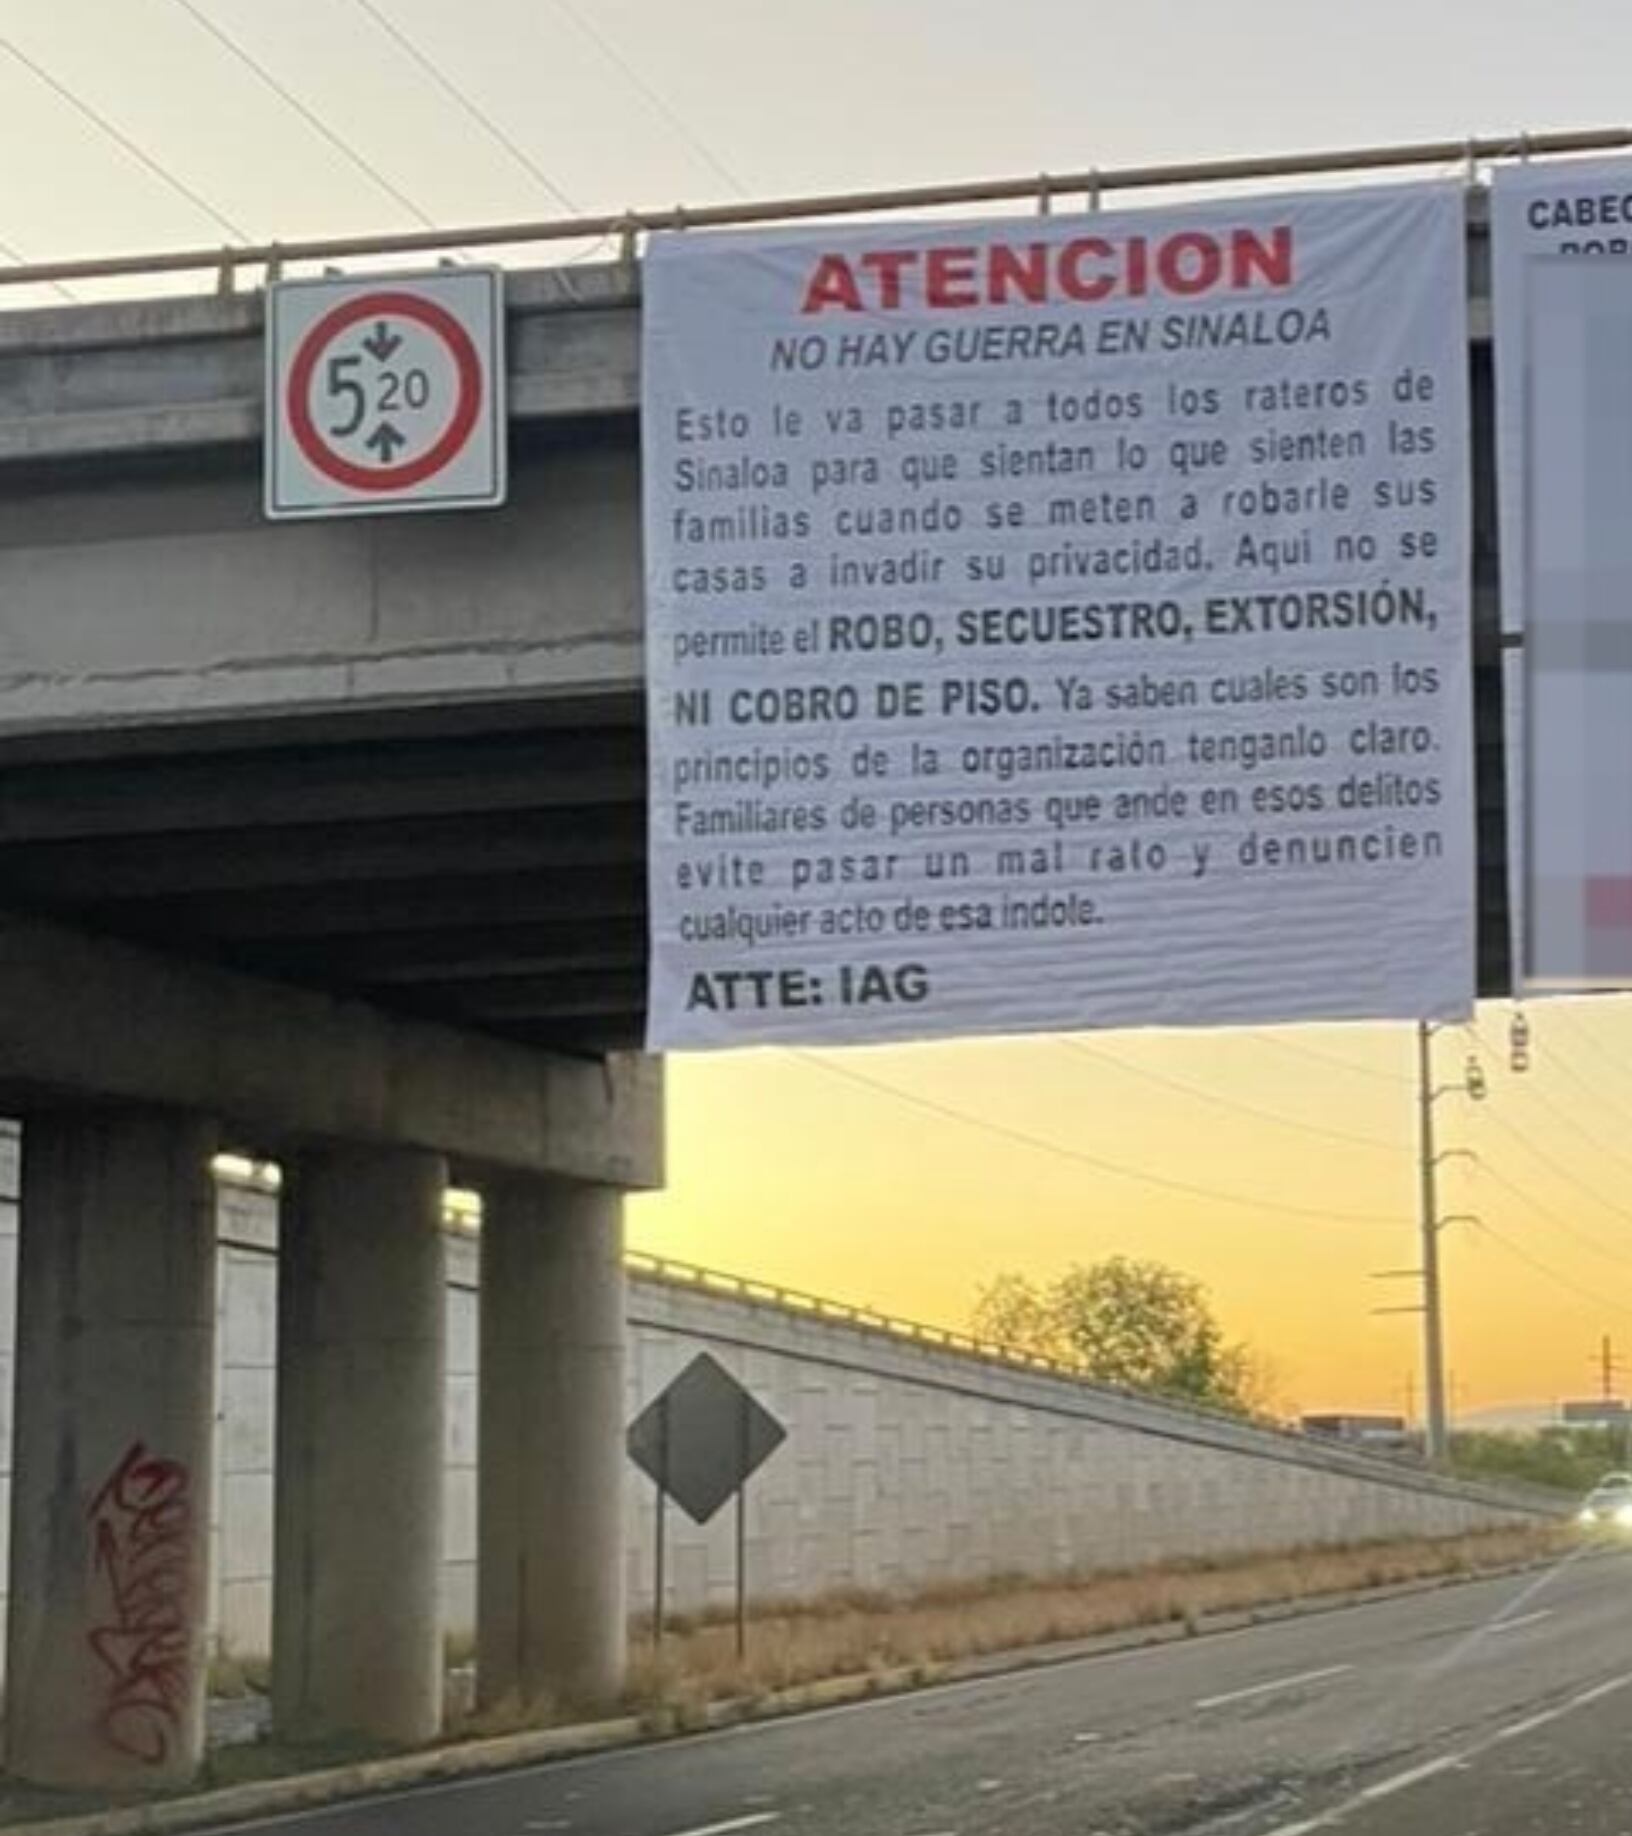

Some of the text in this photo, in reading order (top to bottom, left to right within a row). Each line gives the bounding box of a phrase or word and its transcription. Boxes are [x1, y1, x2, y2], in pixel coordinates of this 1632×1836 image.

[802, 225, 1294, 313] ATENCION
[771, 308, 1330, 370] NO HAY GUERRA EN SINALOA
[677, 368, 1433, 442] Esto le va pasar a todos los rateros de
[674, 420, 1435, 495] Sinaloa para que sientan lo que sienten las
[673, 478, 1436, 543] familias cuando se meten a robarle sus
[673, 566, 767, 594] casas
[790, 563, 807, 589] a
[830, 549, 944, 586] invadir
[967, 556, 1004, 581] su
[1029, 537, 1214, 586] privacidad.
[1336, 535, 1376, 561] no
[1400, 532, 1437, 559] se
[674, 579, 1436, 665] permite el ROBO, SECUESTRO, EXTORSIÓN,
[675, 662, 1440, 726] NI COBRO DE PISO. Ya saben cuales son los
[674, 747, 830, 793] principios
[852, 744, 889, 778] de
[912, 743, 940, 776] la
[962, 731, 1165, 781] organización
[1187, 724, 1327, 771] tenganlo
[675, 773, 1441, 838] Familiares de personas que ande en esos delitos
[677, 853, 765, 890] evite
[792, 855, 900, 891] pasar
[925, 851, 970, 879] un
[997, 839, 1064, 875] mal
[1191, 844, 1209, 878] y
[1238, 825, 1441, 866] denuncien
[679, 902, 812, 948] cualquier
[819, 900, 886, 934] acto
[893, 897, 931, 933] de
[939, 903, 993, 932] esa
[688, 964, 929, 1010] ATTE: IAG
